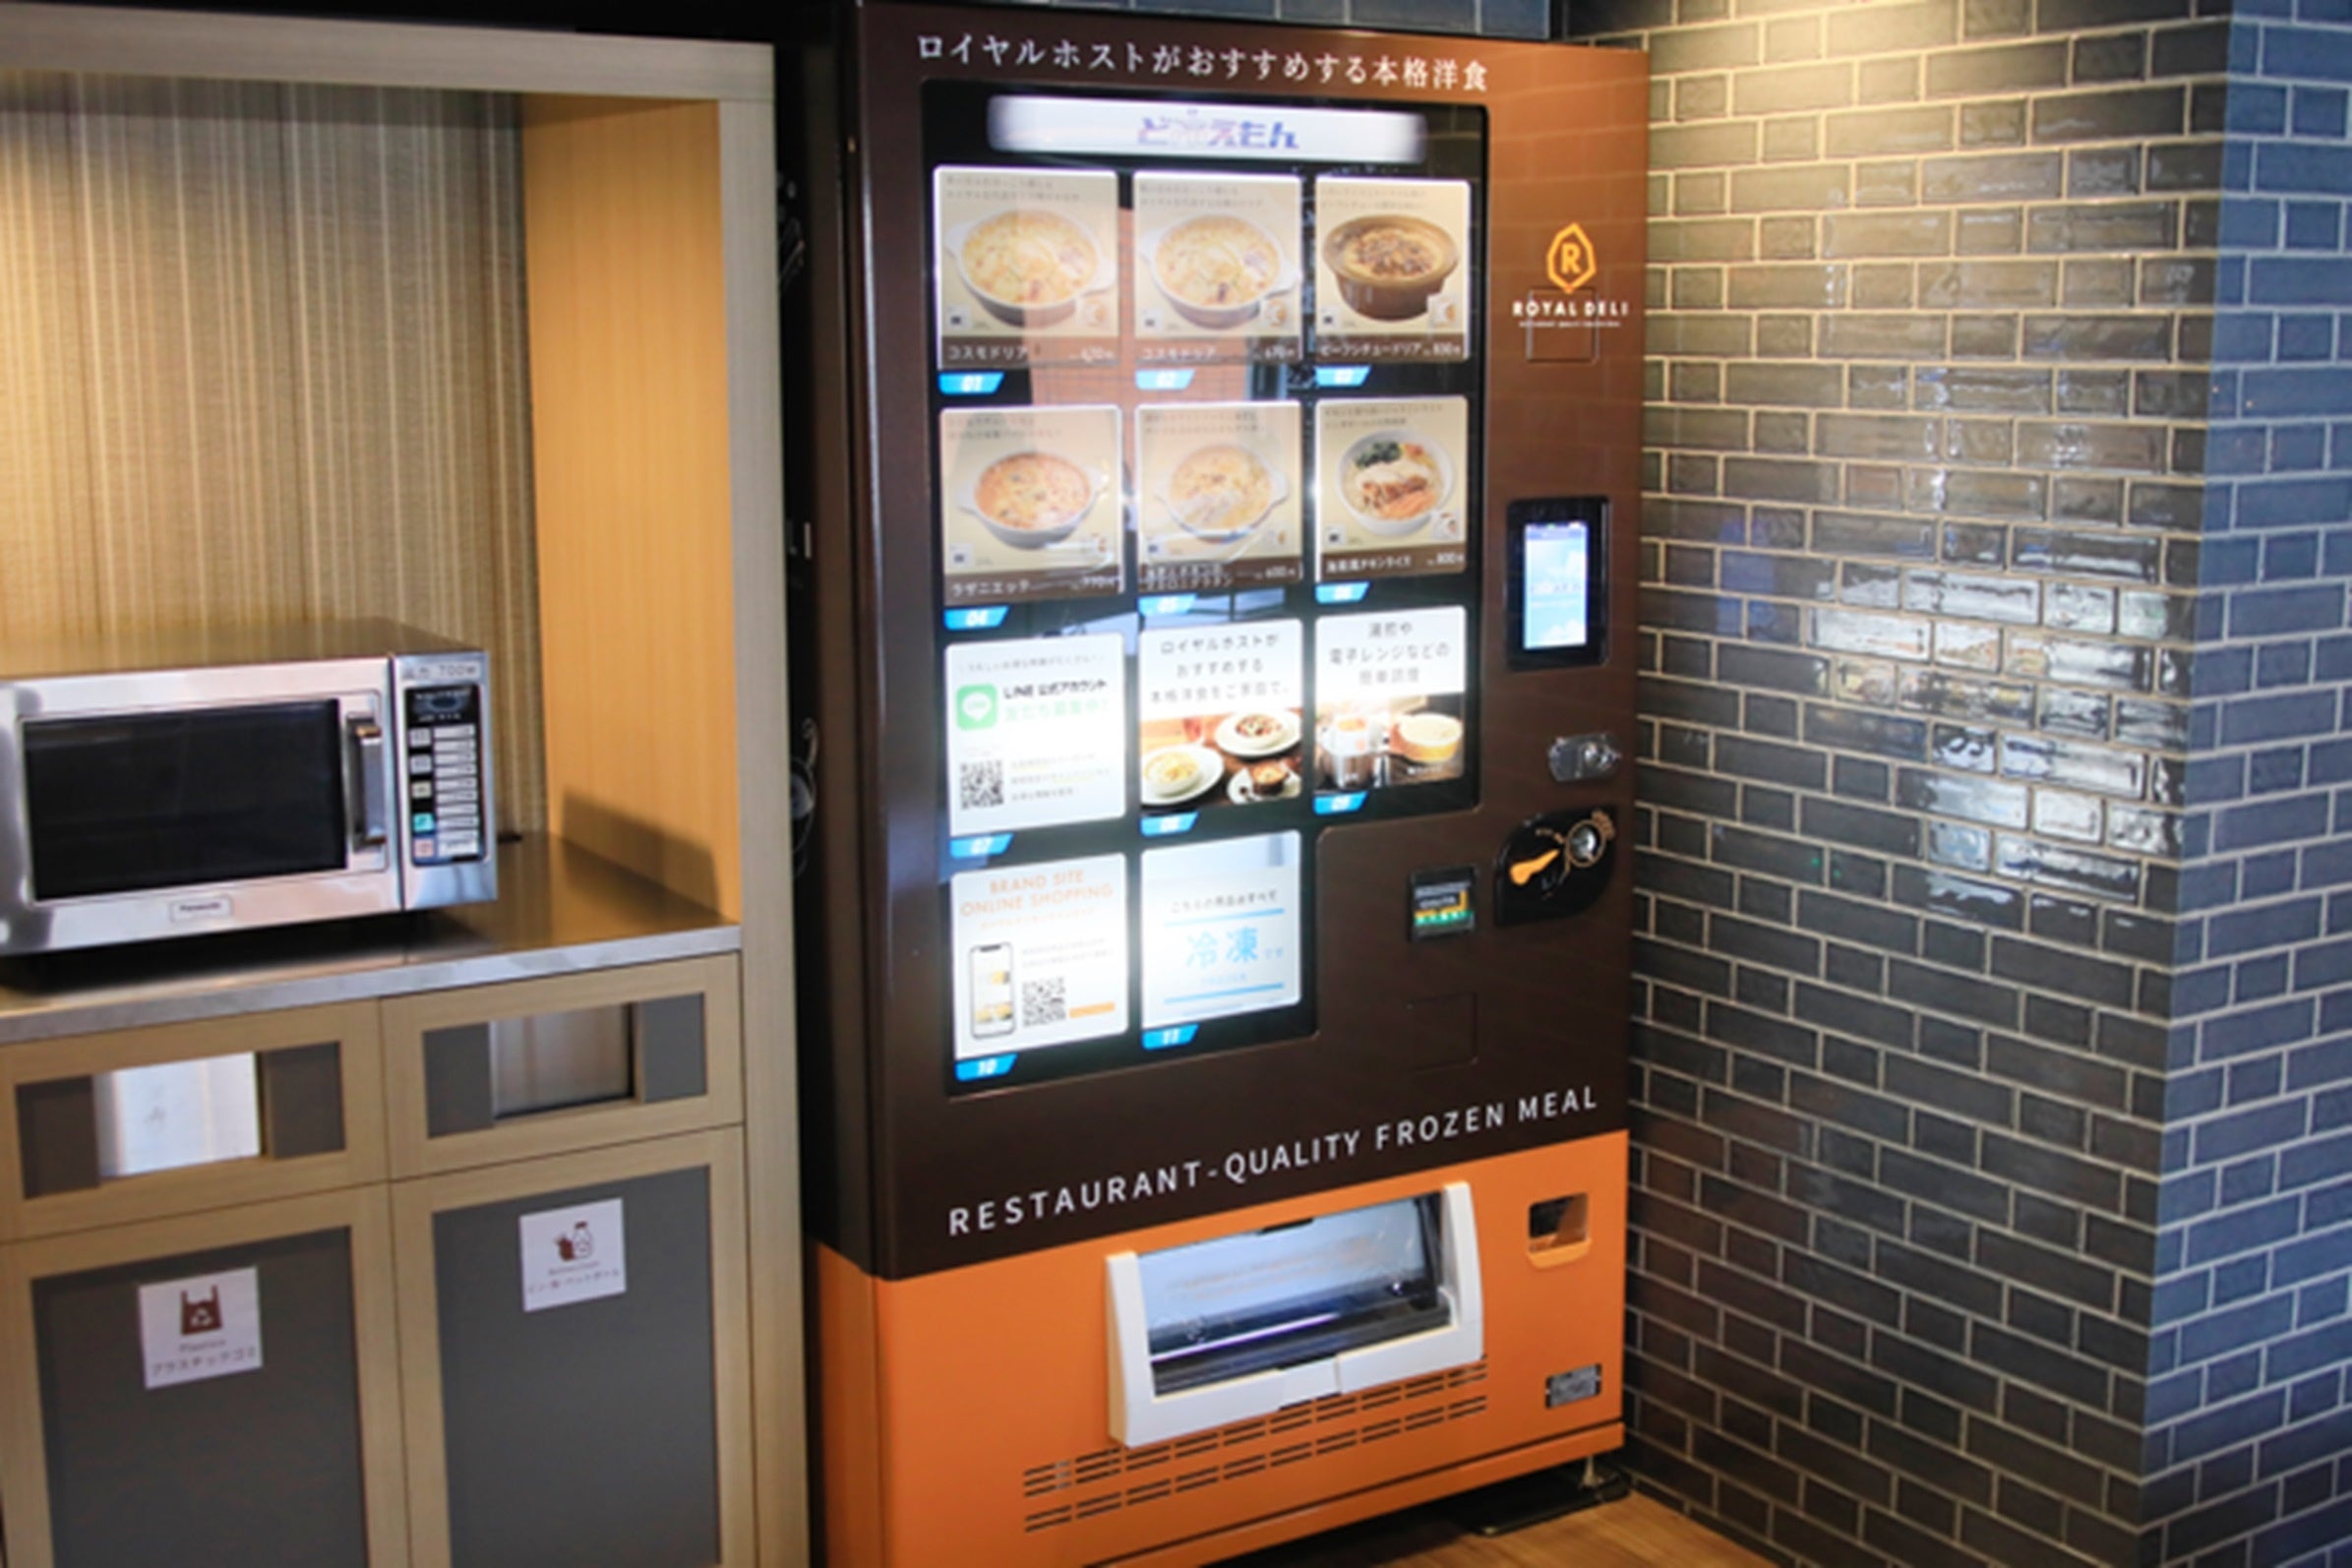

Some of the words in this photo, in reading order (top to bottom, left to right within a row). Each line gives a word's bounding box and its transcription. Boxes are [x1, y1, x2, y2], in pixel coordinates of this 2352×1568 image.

[918, 35, 1487, 91] ロイヤルホストがおすすめする本格洋食
[1137, 111, 1298, 150] どえもん
[1512, 300, 1577, 317] ROYAL
[1585, 299, 1629, 317] DELI
[1375, 1102, 1504, 1151] FROZEN
[1517, 1085, 1598, 1121] MEAL
